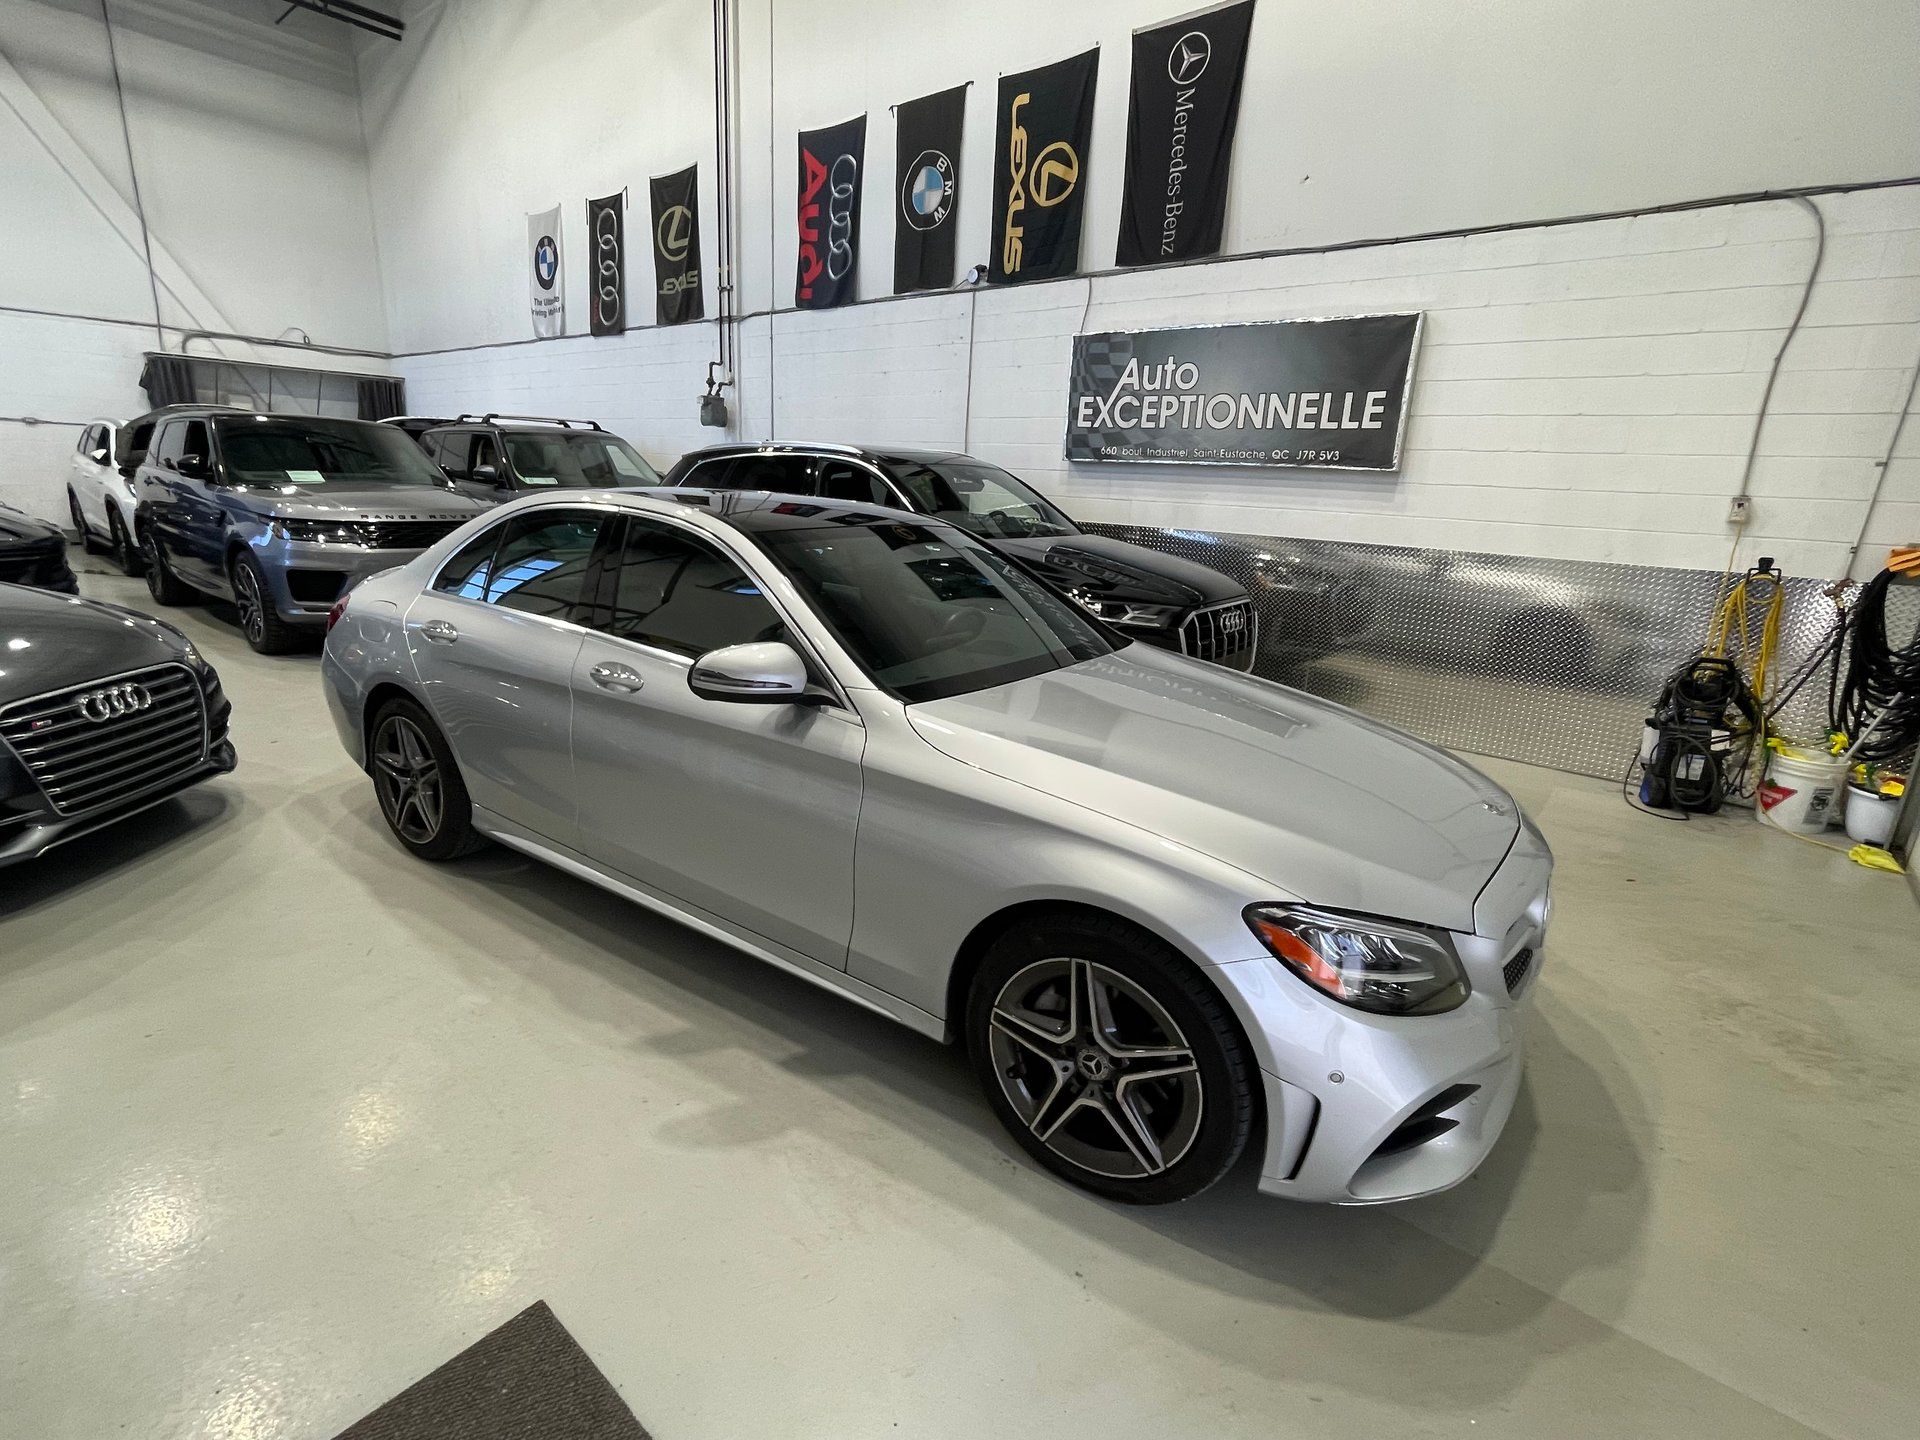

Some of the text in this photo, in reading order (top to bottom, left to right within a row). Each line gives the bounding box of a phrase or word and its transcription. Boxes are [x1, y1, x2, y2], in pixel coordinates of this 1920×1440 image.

[1004, 92, 1031, 275] LEXUS
[1161, 86, 1196, 256] Mercedes-Benz
[1116, 355, 1200, 394] Auto
[1077, 390, 1387, 429] EXCEPTIONNELLE
[1271, 449, 1290, 460] QC
[1296, 450, 1315, 460] J7R
[1319, 450, 1340, 461] 5V3
